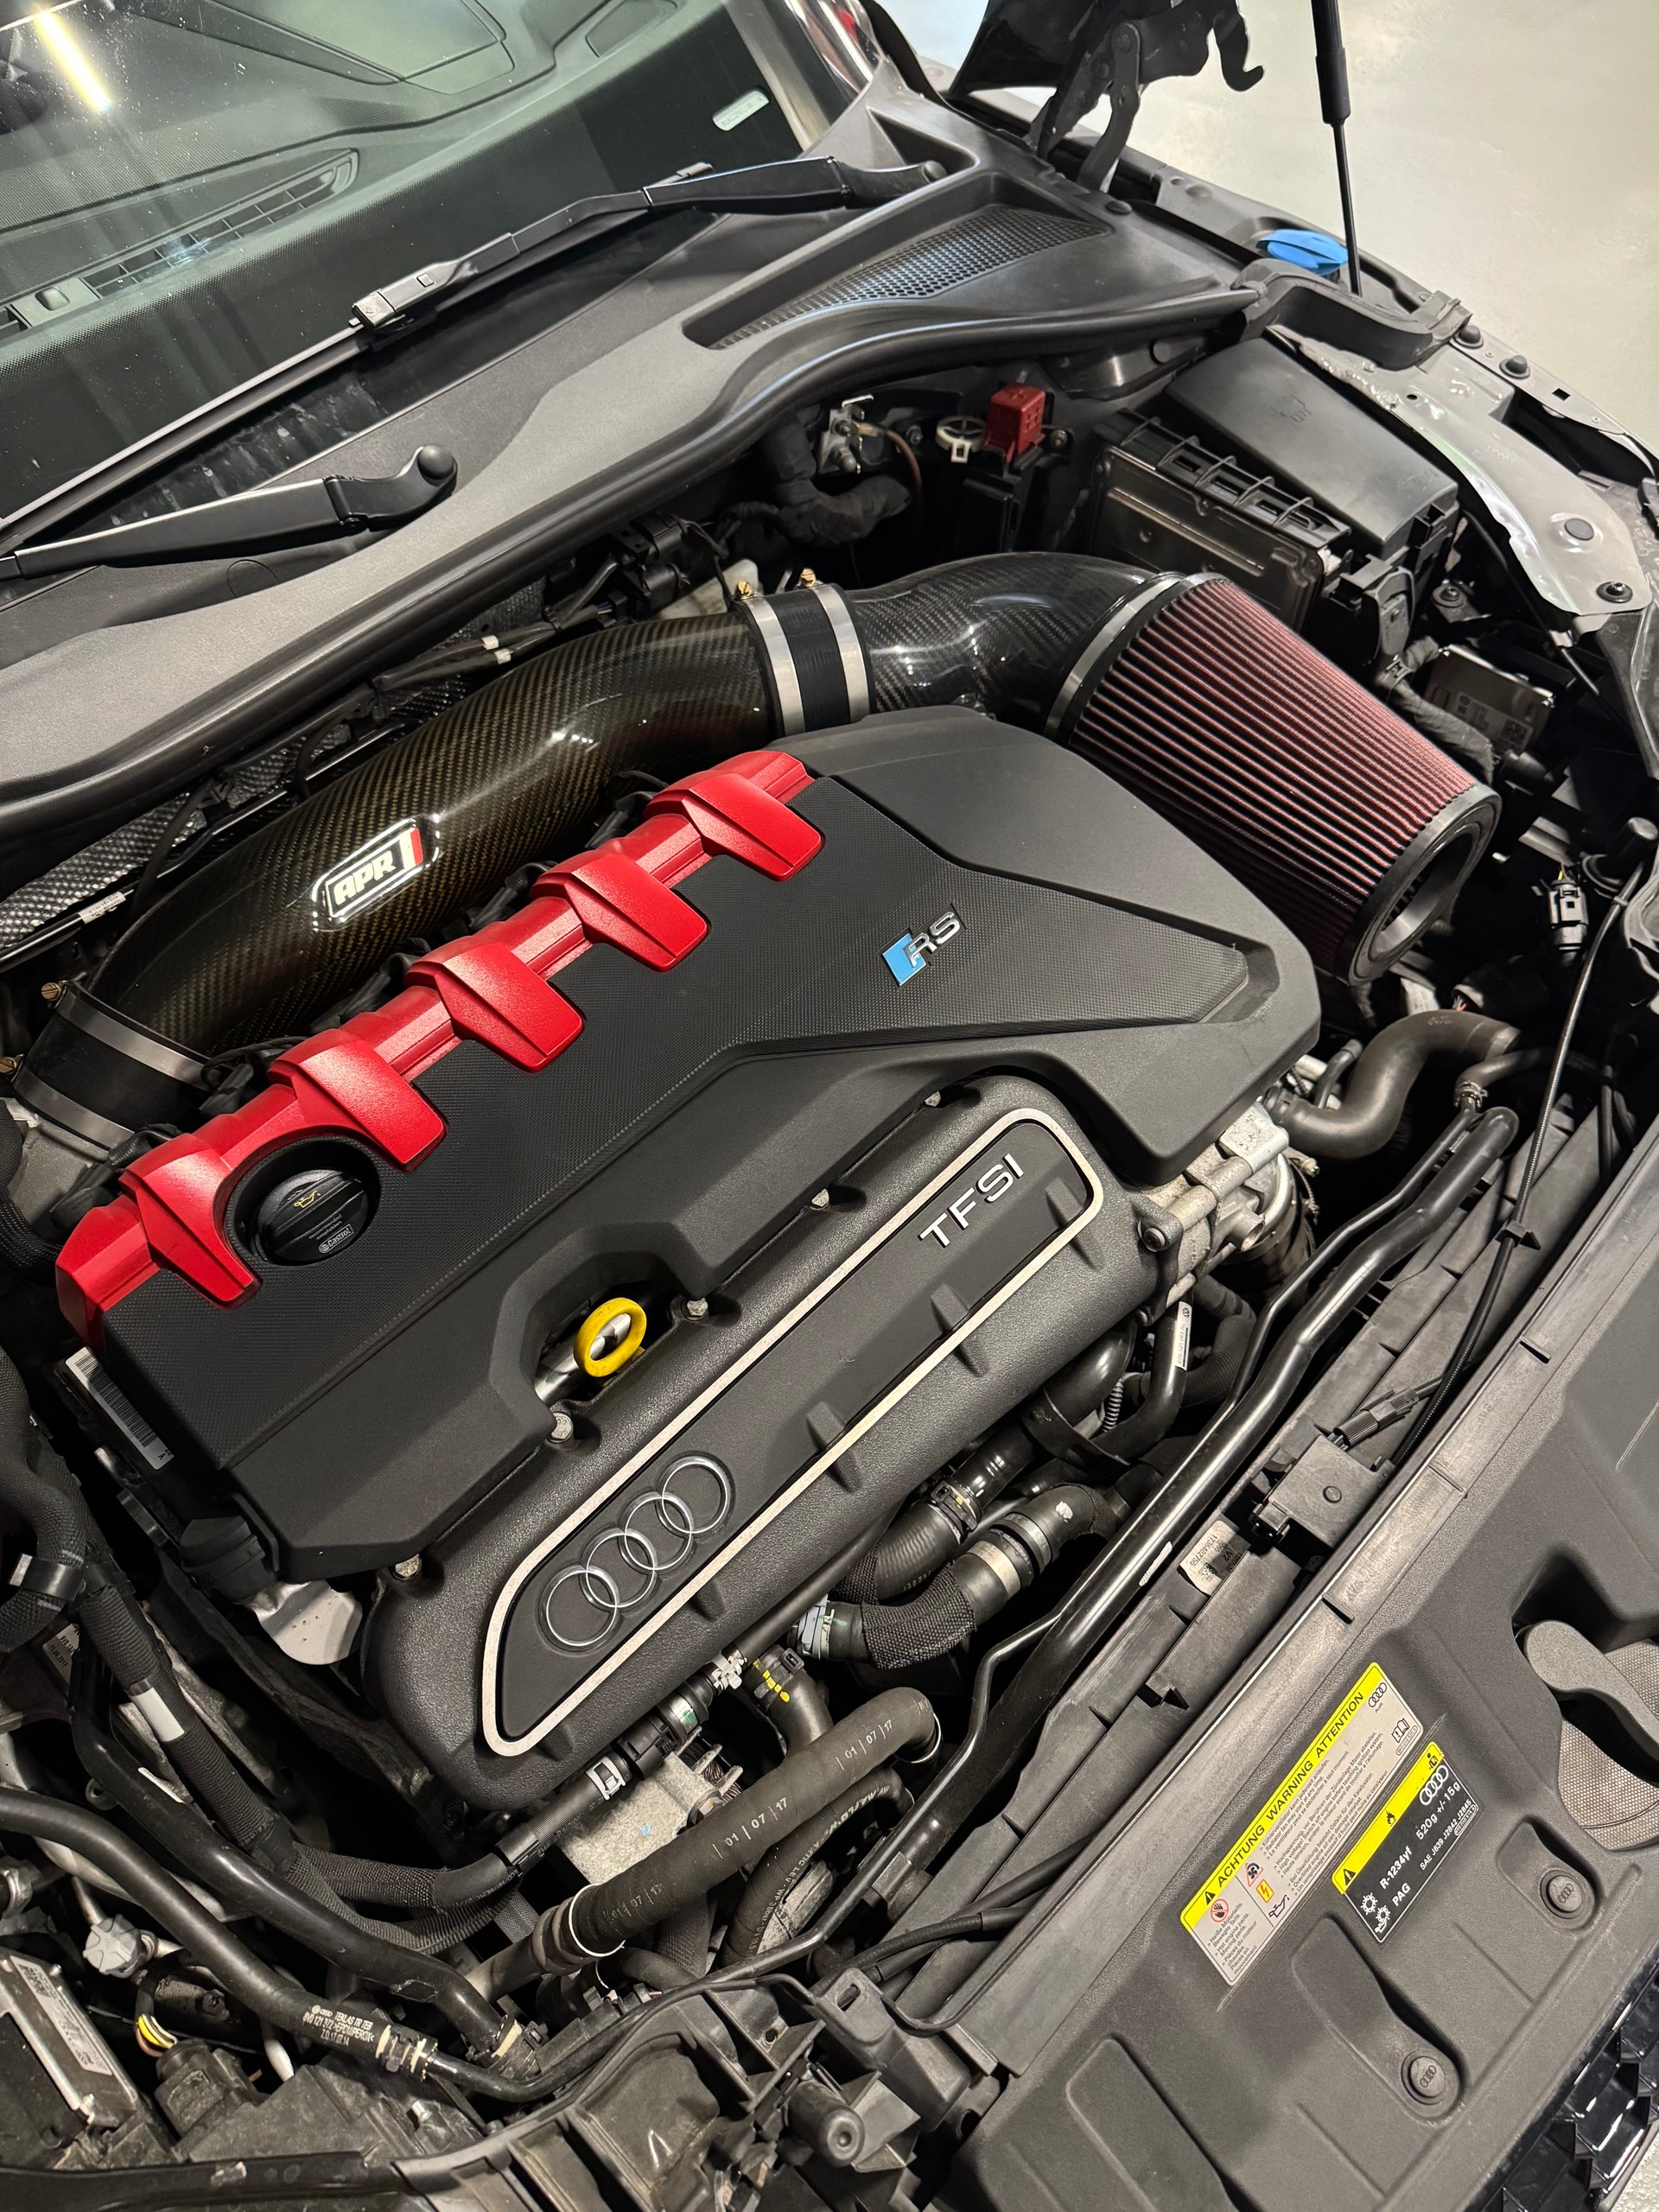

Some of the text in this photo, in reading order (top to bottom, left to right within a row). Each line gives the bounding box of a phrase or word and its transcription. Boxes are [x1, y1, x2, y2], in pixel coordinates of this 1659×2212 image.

[334, 849, 396, 905] APR
[903, 912, 961, 967] RS
[917, 1153, 1024, 1248] TFSI
[327, 1227, 351, 1247] Castrol
[843, 1719, 893, 1759] 01 07 17
[1350, 1751, 1361, 1766] Motor
[1216, 1691, 1363, 1887] ACHTUNG WARNING ATTENTION
[1262, 1808, 1290, 1847] Kühlerventilator
[1289, 1797, 1299, 1810] kann
[1298, 1777, 1314, 1800] jederzeit
[1265, 1830, 1281, 1852] Radiator
[1280, 1821, 1288, 1831] fan
[1287, 1811, 1296, 1824] may
[1294, 1800, 1304, 1813] start
[1306, 1787, 1315, 1797] any
[1313, 1774, 1324, 1788] time.
[1274, 1824, 1293, 1850] ventilateur
[1293, 1813, 1302, 1826] peut
[1325, 1769, 1334, 1780] tout
[1280, 1857, 1289, 1871] High
[1302, 1821, 1315, 1839] Switch
[1319, 1799, 1333, 1817] engine
[1332, 1784, 1344, 1801] before
[1342, 1764, 1358, 1786] touching
[1357, 1748, 1370, 1767] ignition
[723, 1796, 790, 1847] 01 07 17
[1283, 1859, 1294, 1874] Haute
[1323, 1803, 1336, 1821] moteur
[1335, 1790, 1346, 1804] avant
[1349, 1767, 1363, 1785] toucher
[1297, 1883, 1303, 1892] Un
[1349, 1810, 1358, 1823] peut
[1357, 1798, 1367, 1812] nuire
[1310, 1847, 1324, 1866] engine
[1333, 1813, 1349, 1834] damage
[1316, 1828, 1331, 1847] besteht
[1329, 1813, 1342, 1830] Gefahr
[1419, 1853, 1432, 1871] SAE
[1429, 1836, 1444, 1856] J639
[1441, 1817, 1458, 1840] J2842
[1455, 1797, 1471, 1820] J2845
[1378, 1844, 1414, 1891] R-1234yf
[1415, 1810, 1438, 1842] 520g
[1391, 1881, 1410, 1907] PAG
[1209, 1925, 1223, 1942] Heiße
[1212, 1923, 1230, 1948] Bewegte
[1217, 1910, 1249, 1953] Hot engine parts.
[1220, 1936, 1236, 1957] Moving
[1224, 1920, 1257, 1962] Pièces du moteur
[1230, 1946, 1249, 1970] Pièces en
[334, 2011, 355, 2024] TEKLAS
